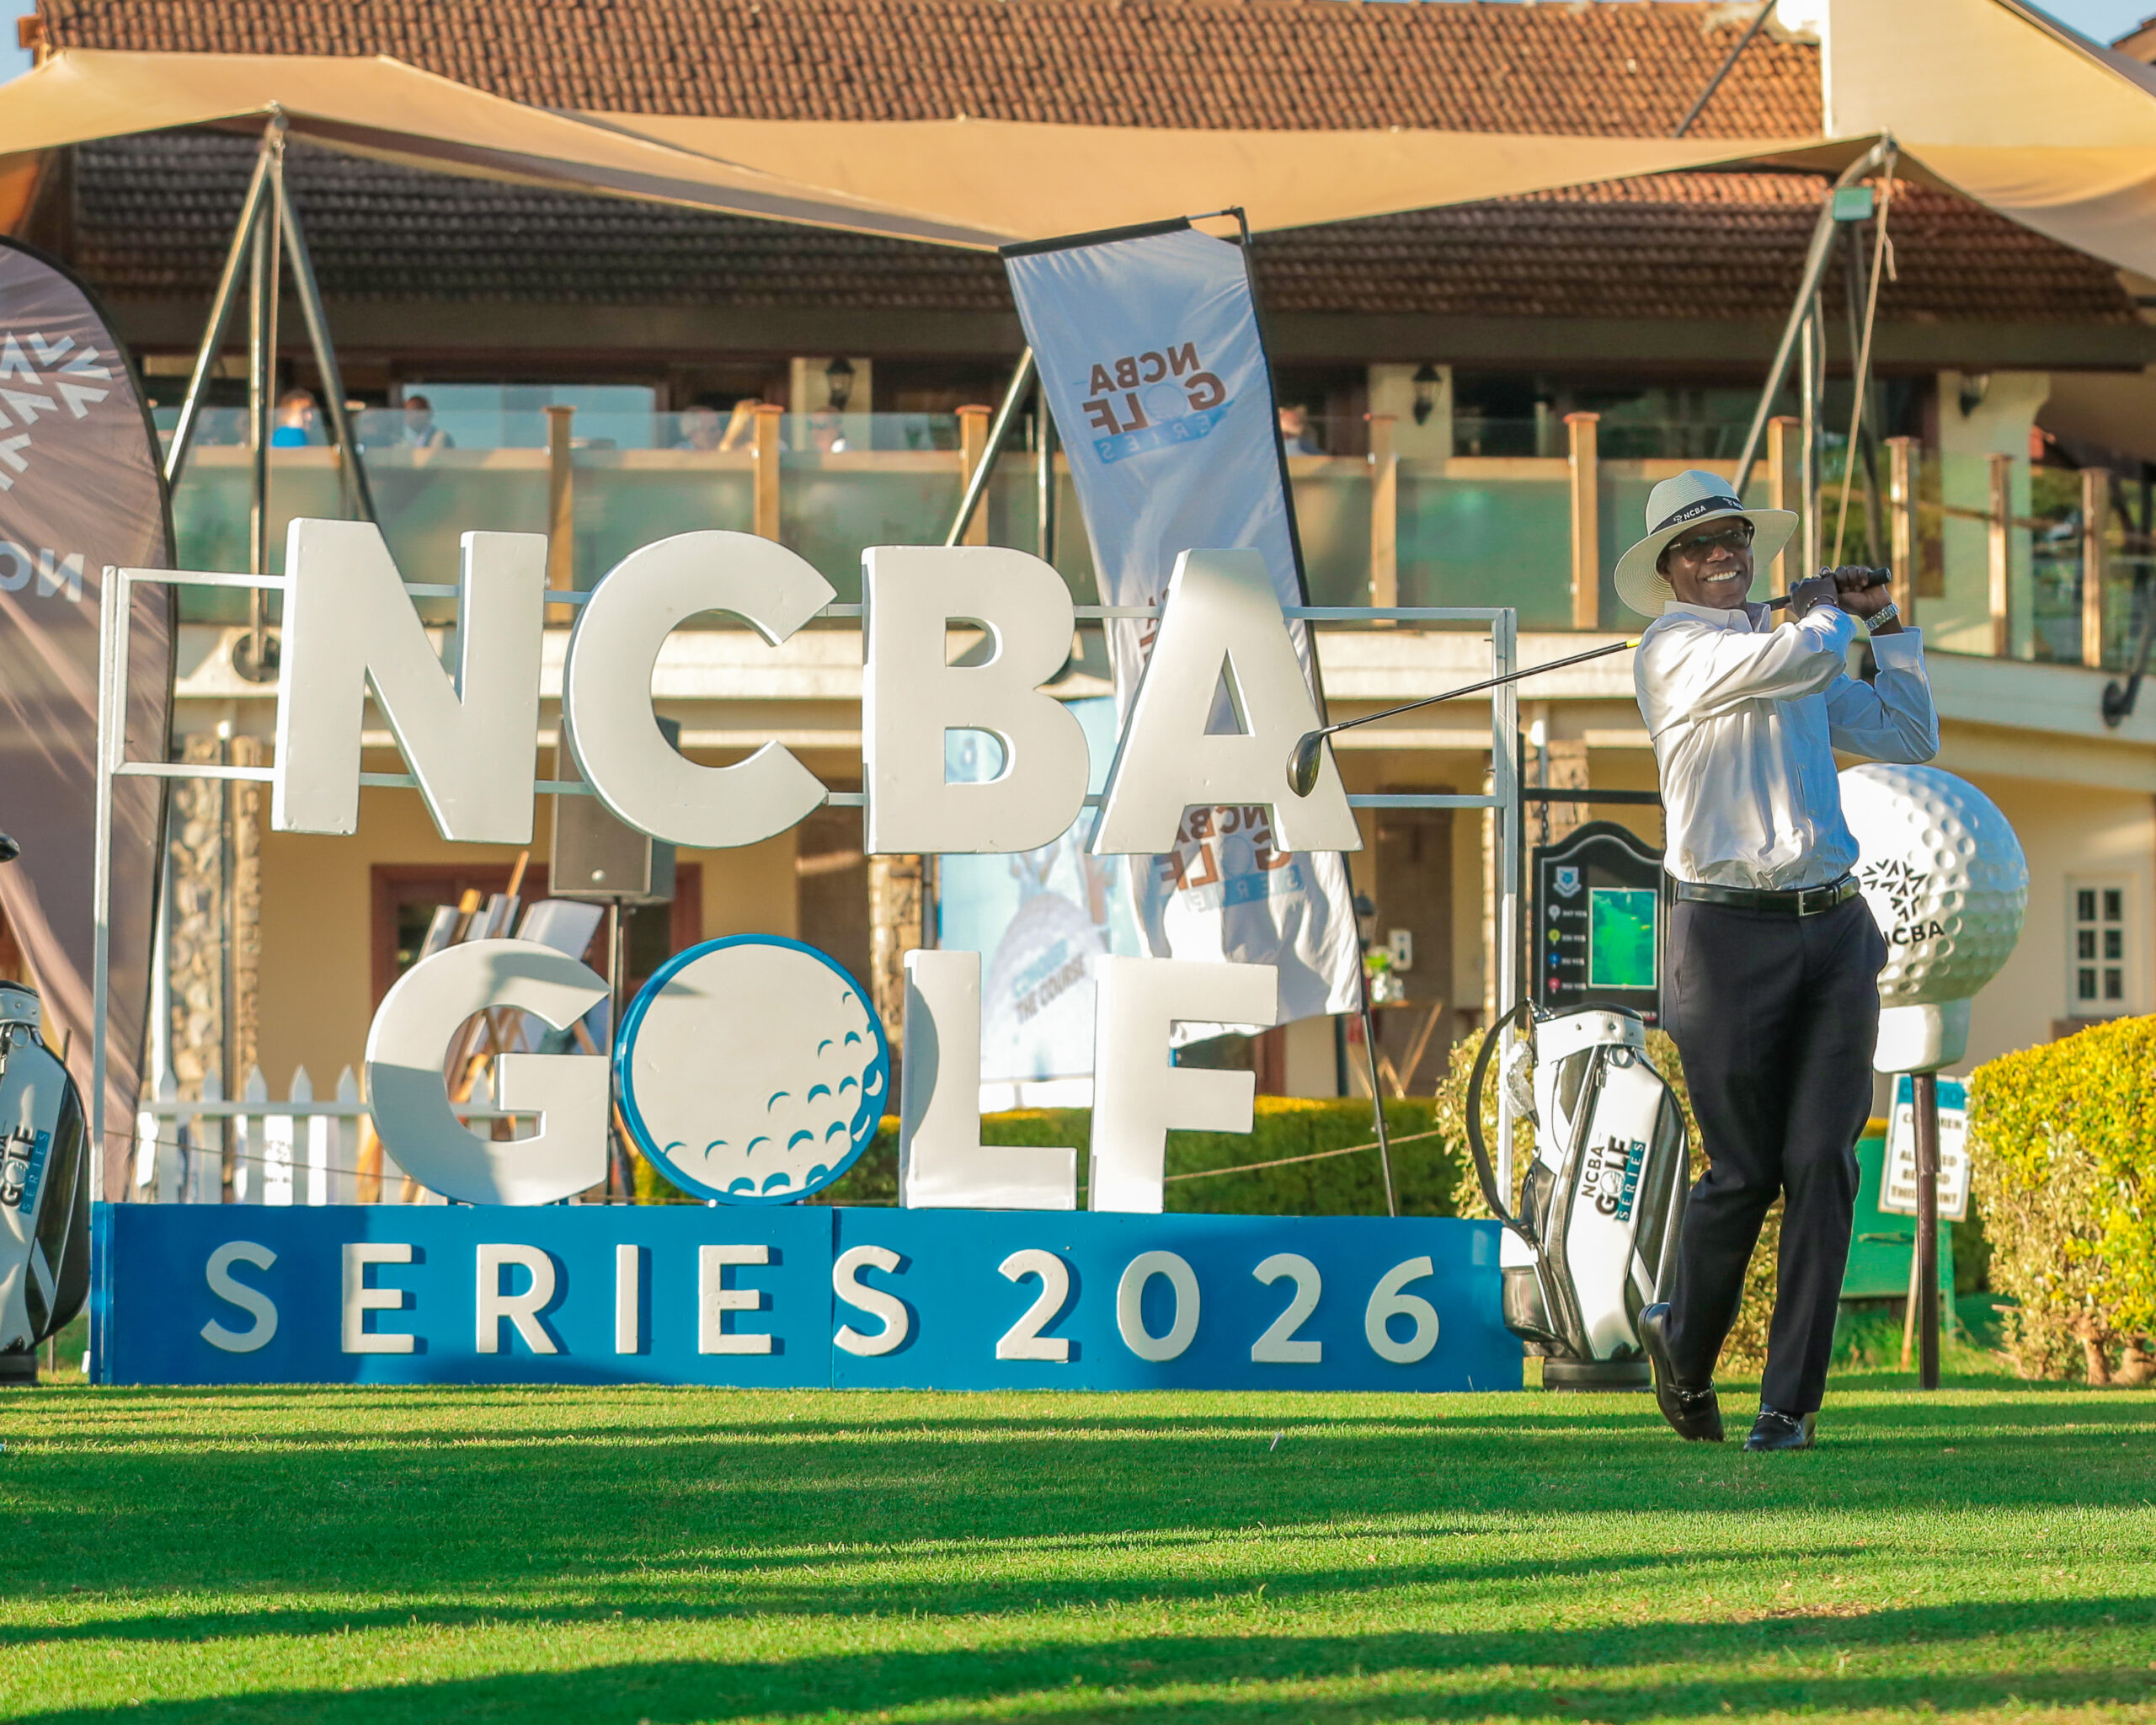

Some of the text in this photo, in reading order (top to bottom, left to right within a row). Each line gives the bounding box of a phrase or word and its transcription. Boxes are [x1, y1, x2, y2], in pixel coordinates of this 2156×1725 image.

[1684, 505, 1706, 520] NCBA
[271, 517, 1363, 855] NCBA
[365, 933, 1279, 1214] GOLF
[22, 1133, 48, 1210] SERIES
[1581, 1146, 1604, 1198] NCBA
[1619, 1143, 1644, 1220] SERIES
[200, 1240, 1440, 1365] SERIES 2026
